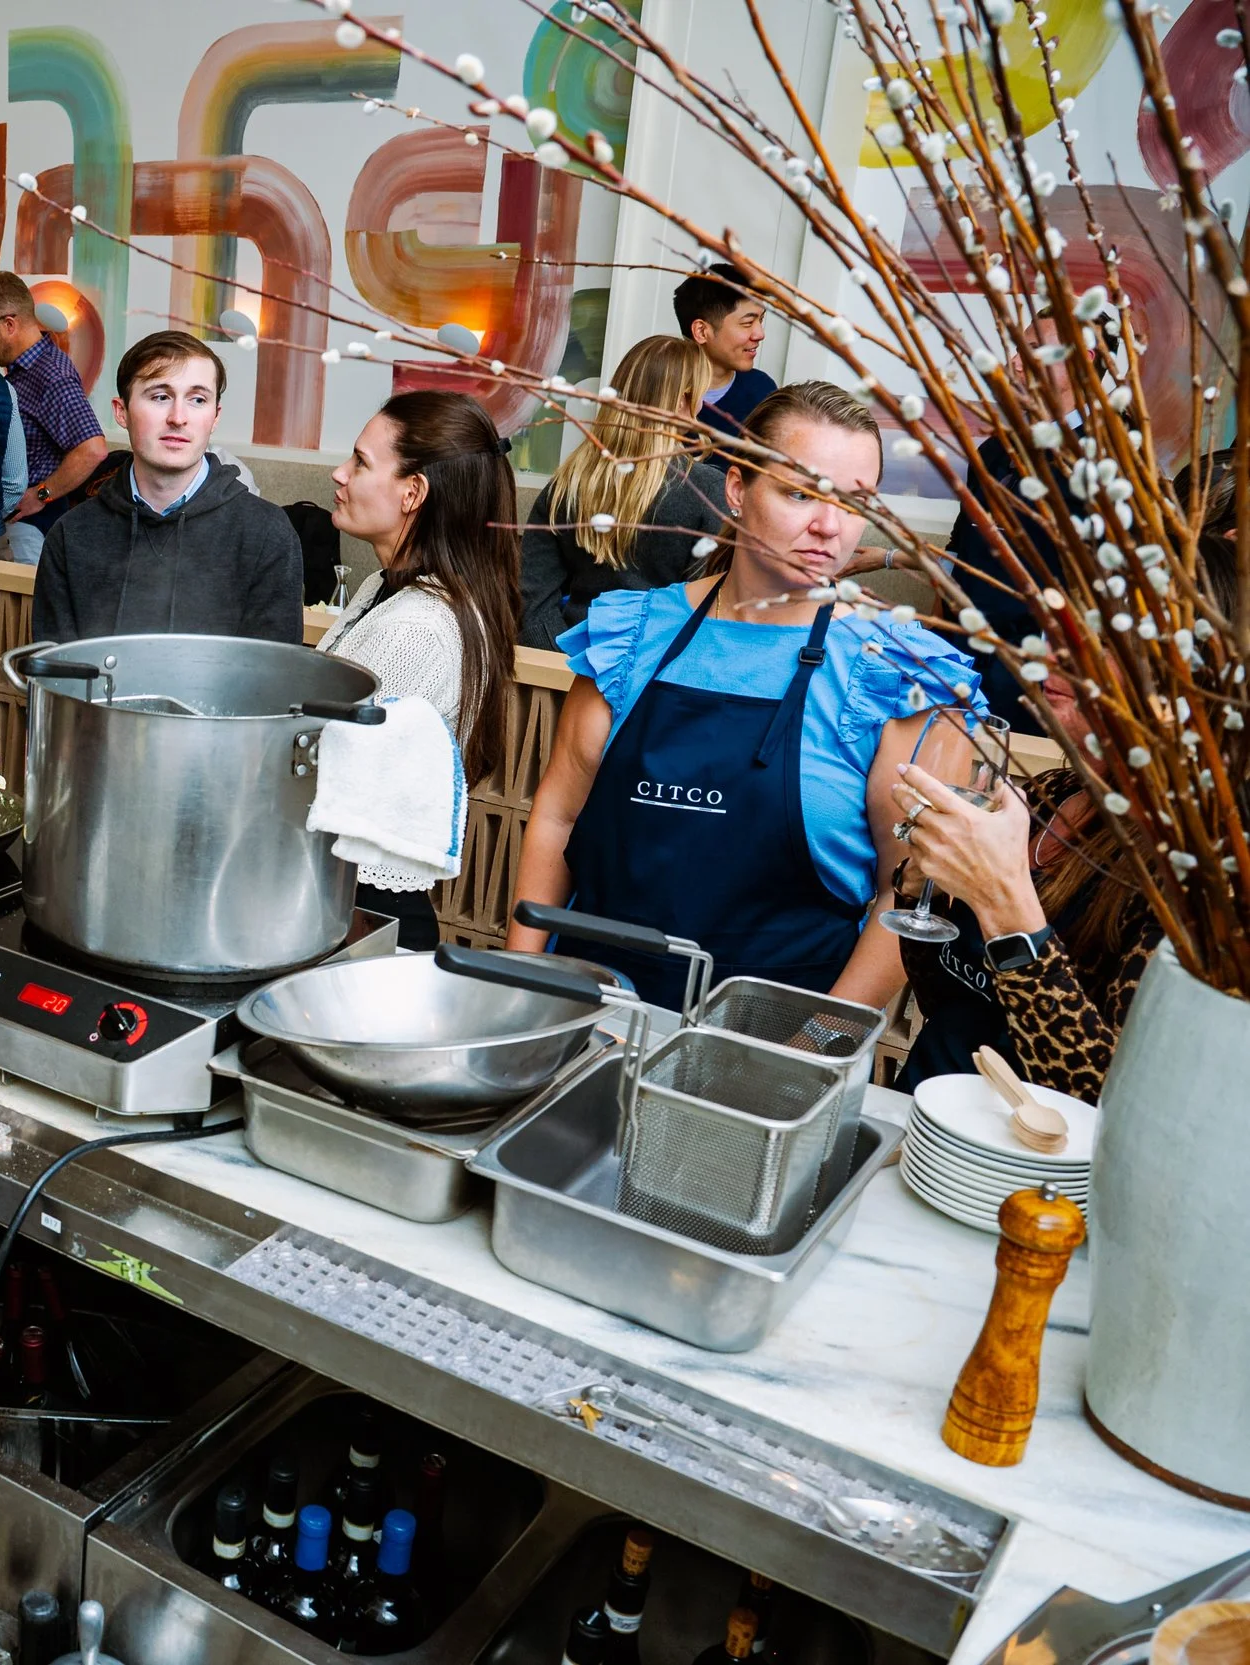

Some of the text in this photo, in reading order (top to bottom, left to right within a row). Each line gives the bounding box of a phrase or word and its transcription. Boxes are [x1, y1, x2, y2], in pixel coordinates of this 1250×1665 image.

[637, 781, 722, 804] CITCO
[942, 941, 986, 989] CITCO
[43, 996, 68, 1013] 20
